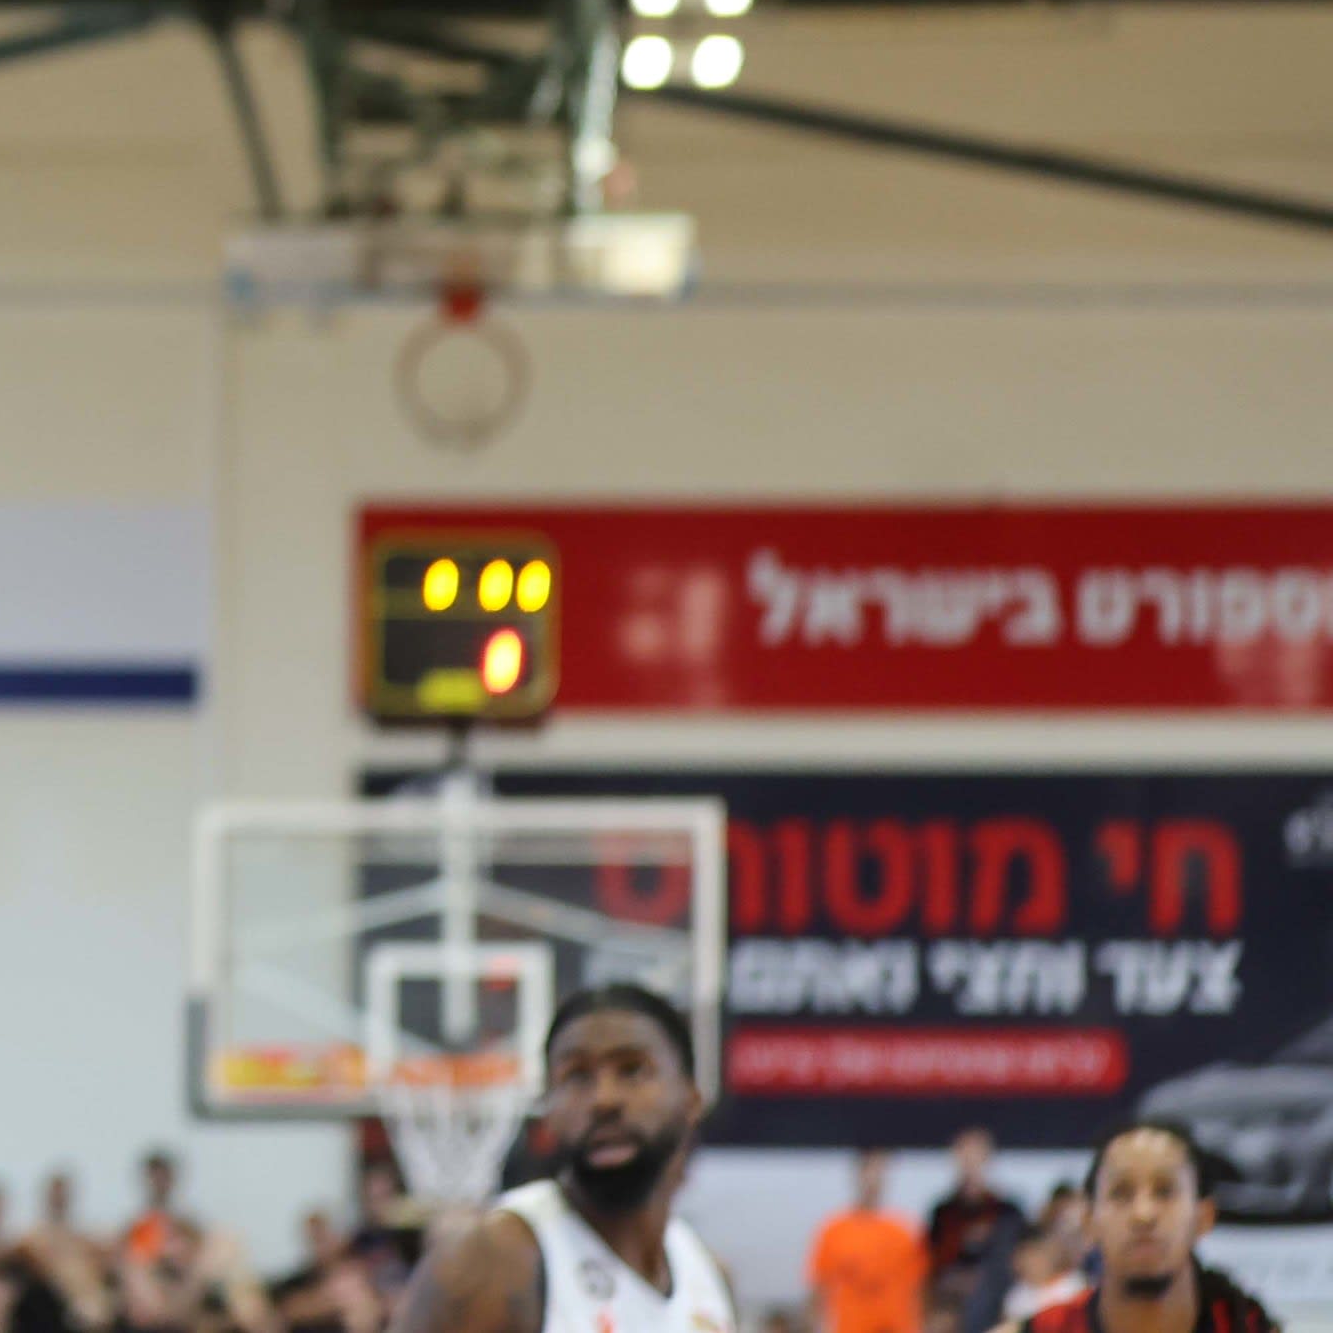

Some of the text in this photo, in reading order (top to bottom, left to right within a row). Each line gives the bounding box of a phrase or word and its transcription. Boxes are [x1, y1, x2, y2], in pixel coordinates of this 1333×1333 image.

[745, 546, 1333, 647] ספורט בישראל
[1095, 816, 1244, 936] חי
